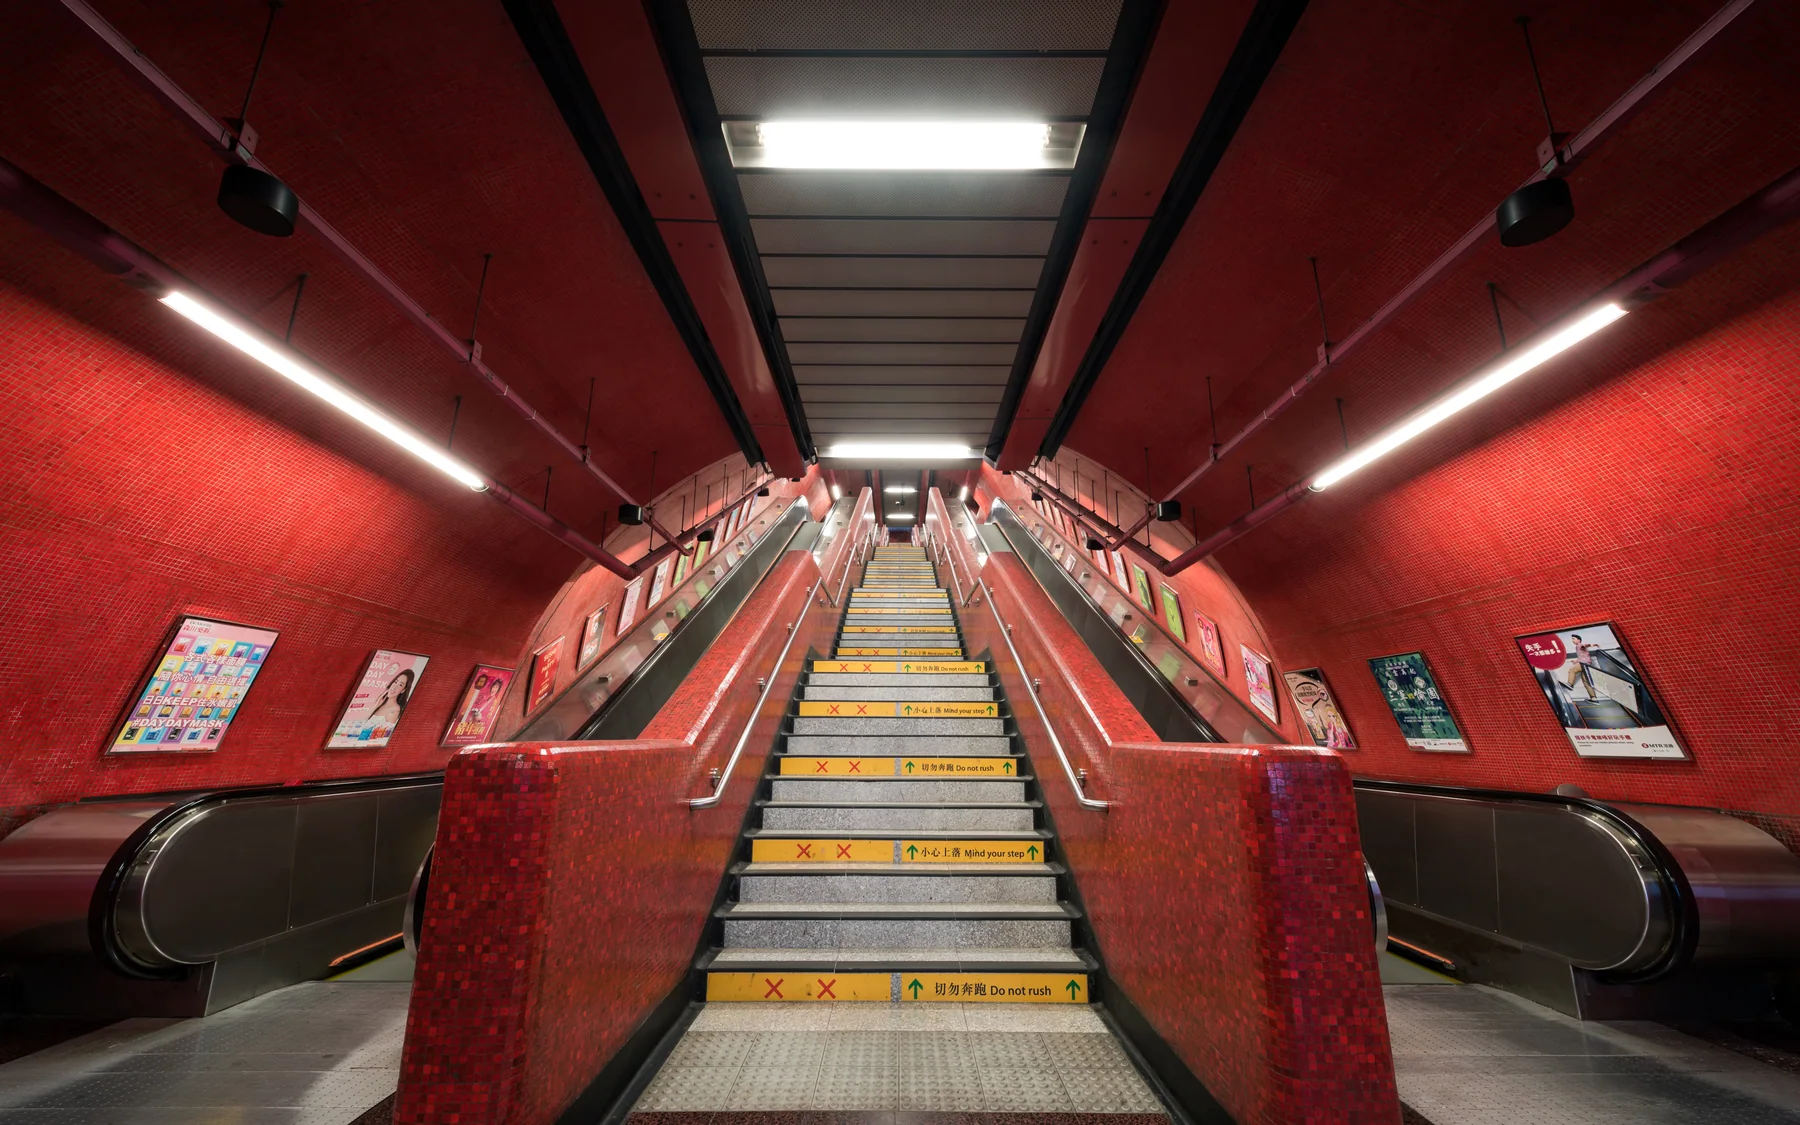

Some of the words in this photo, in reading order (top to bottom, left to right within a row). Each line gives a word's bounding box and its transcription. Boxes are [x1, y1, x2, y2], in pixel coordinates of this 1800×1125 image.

[371, 661, 390, 670] DAY
[365, 670, 385, 679] DAY
[361, 679, 389, 689] MASK
[913, 706, 942, 714] 小心上落
[131, 718, 225, 729] #DAYDAYMASK
[921, 763, 955, 772] 切勿奔跑
[921, 847, 961, 858] 小心上落
[964, 849, 986, 858] Mind
[987, 851, 1006, 860] your
[1007, 850, 1025, 860] step
[934, 982, 987, 997] 切勿奔跑
[990, 985, 1005, 996] Do
[1008, 986, 1026, 996] not
[1028, 985, 1052, 996] rush
